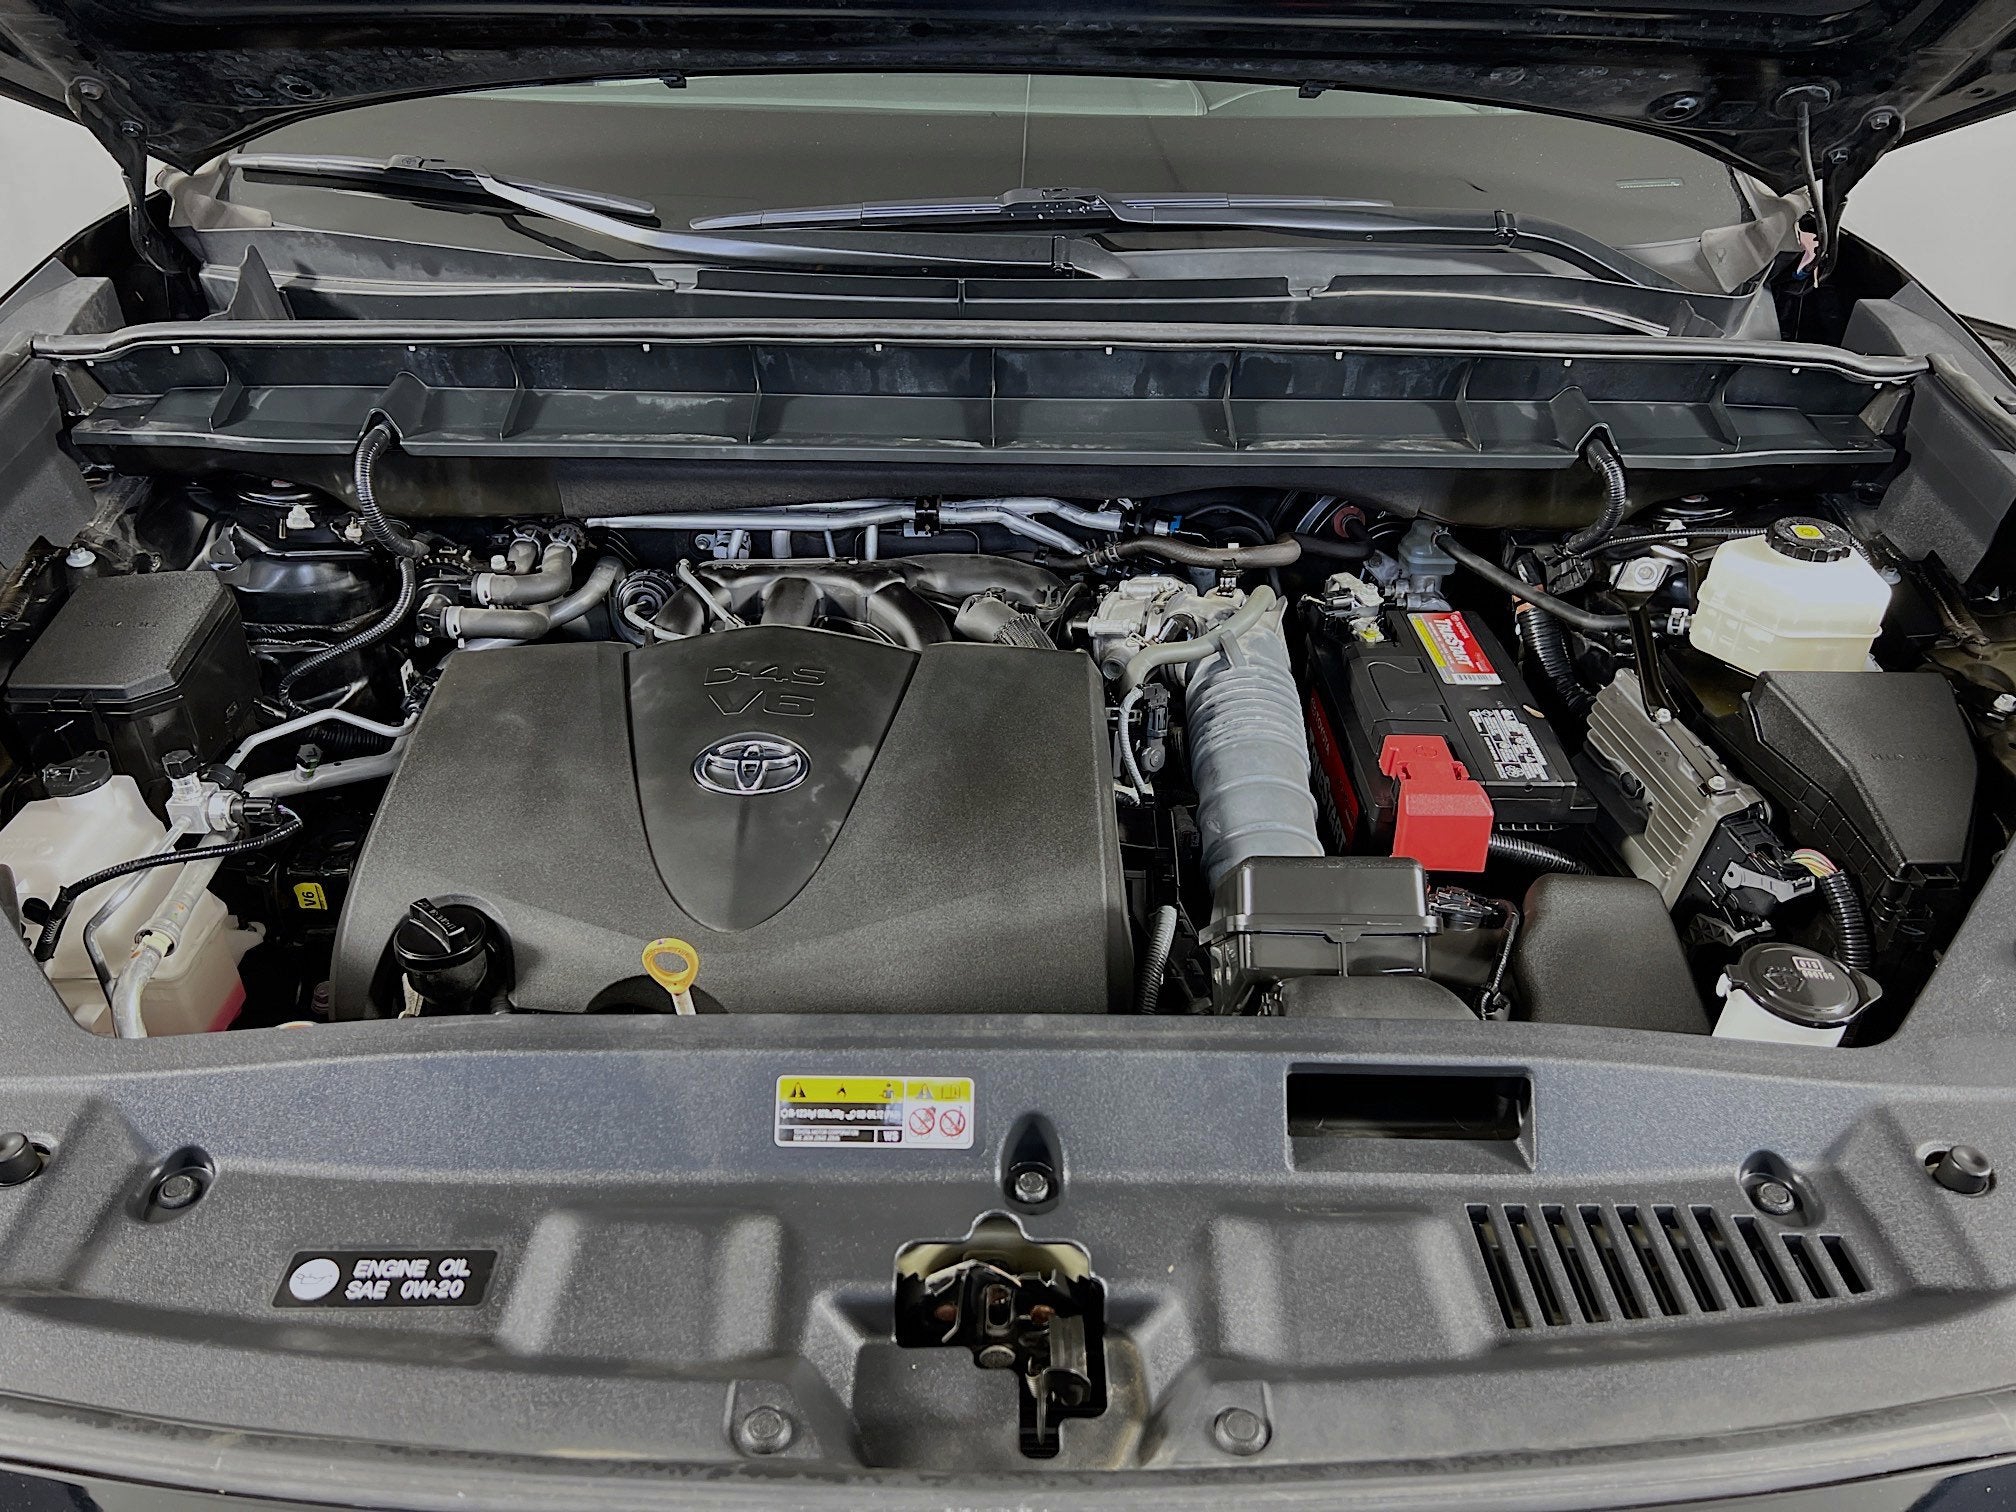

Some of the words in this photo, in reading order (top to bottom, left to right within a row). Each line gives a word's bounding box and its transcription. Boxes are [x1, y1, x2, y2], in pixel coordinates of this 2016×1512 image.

[302, 891, 317, 907] V6
[353, 1259, 430, 1278] ENGINE
[437, 1258, 471, 1278] OIL
[345, 1280, 390, 1300] SAE
[400, 1279, 465, 1299] 0W-20
